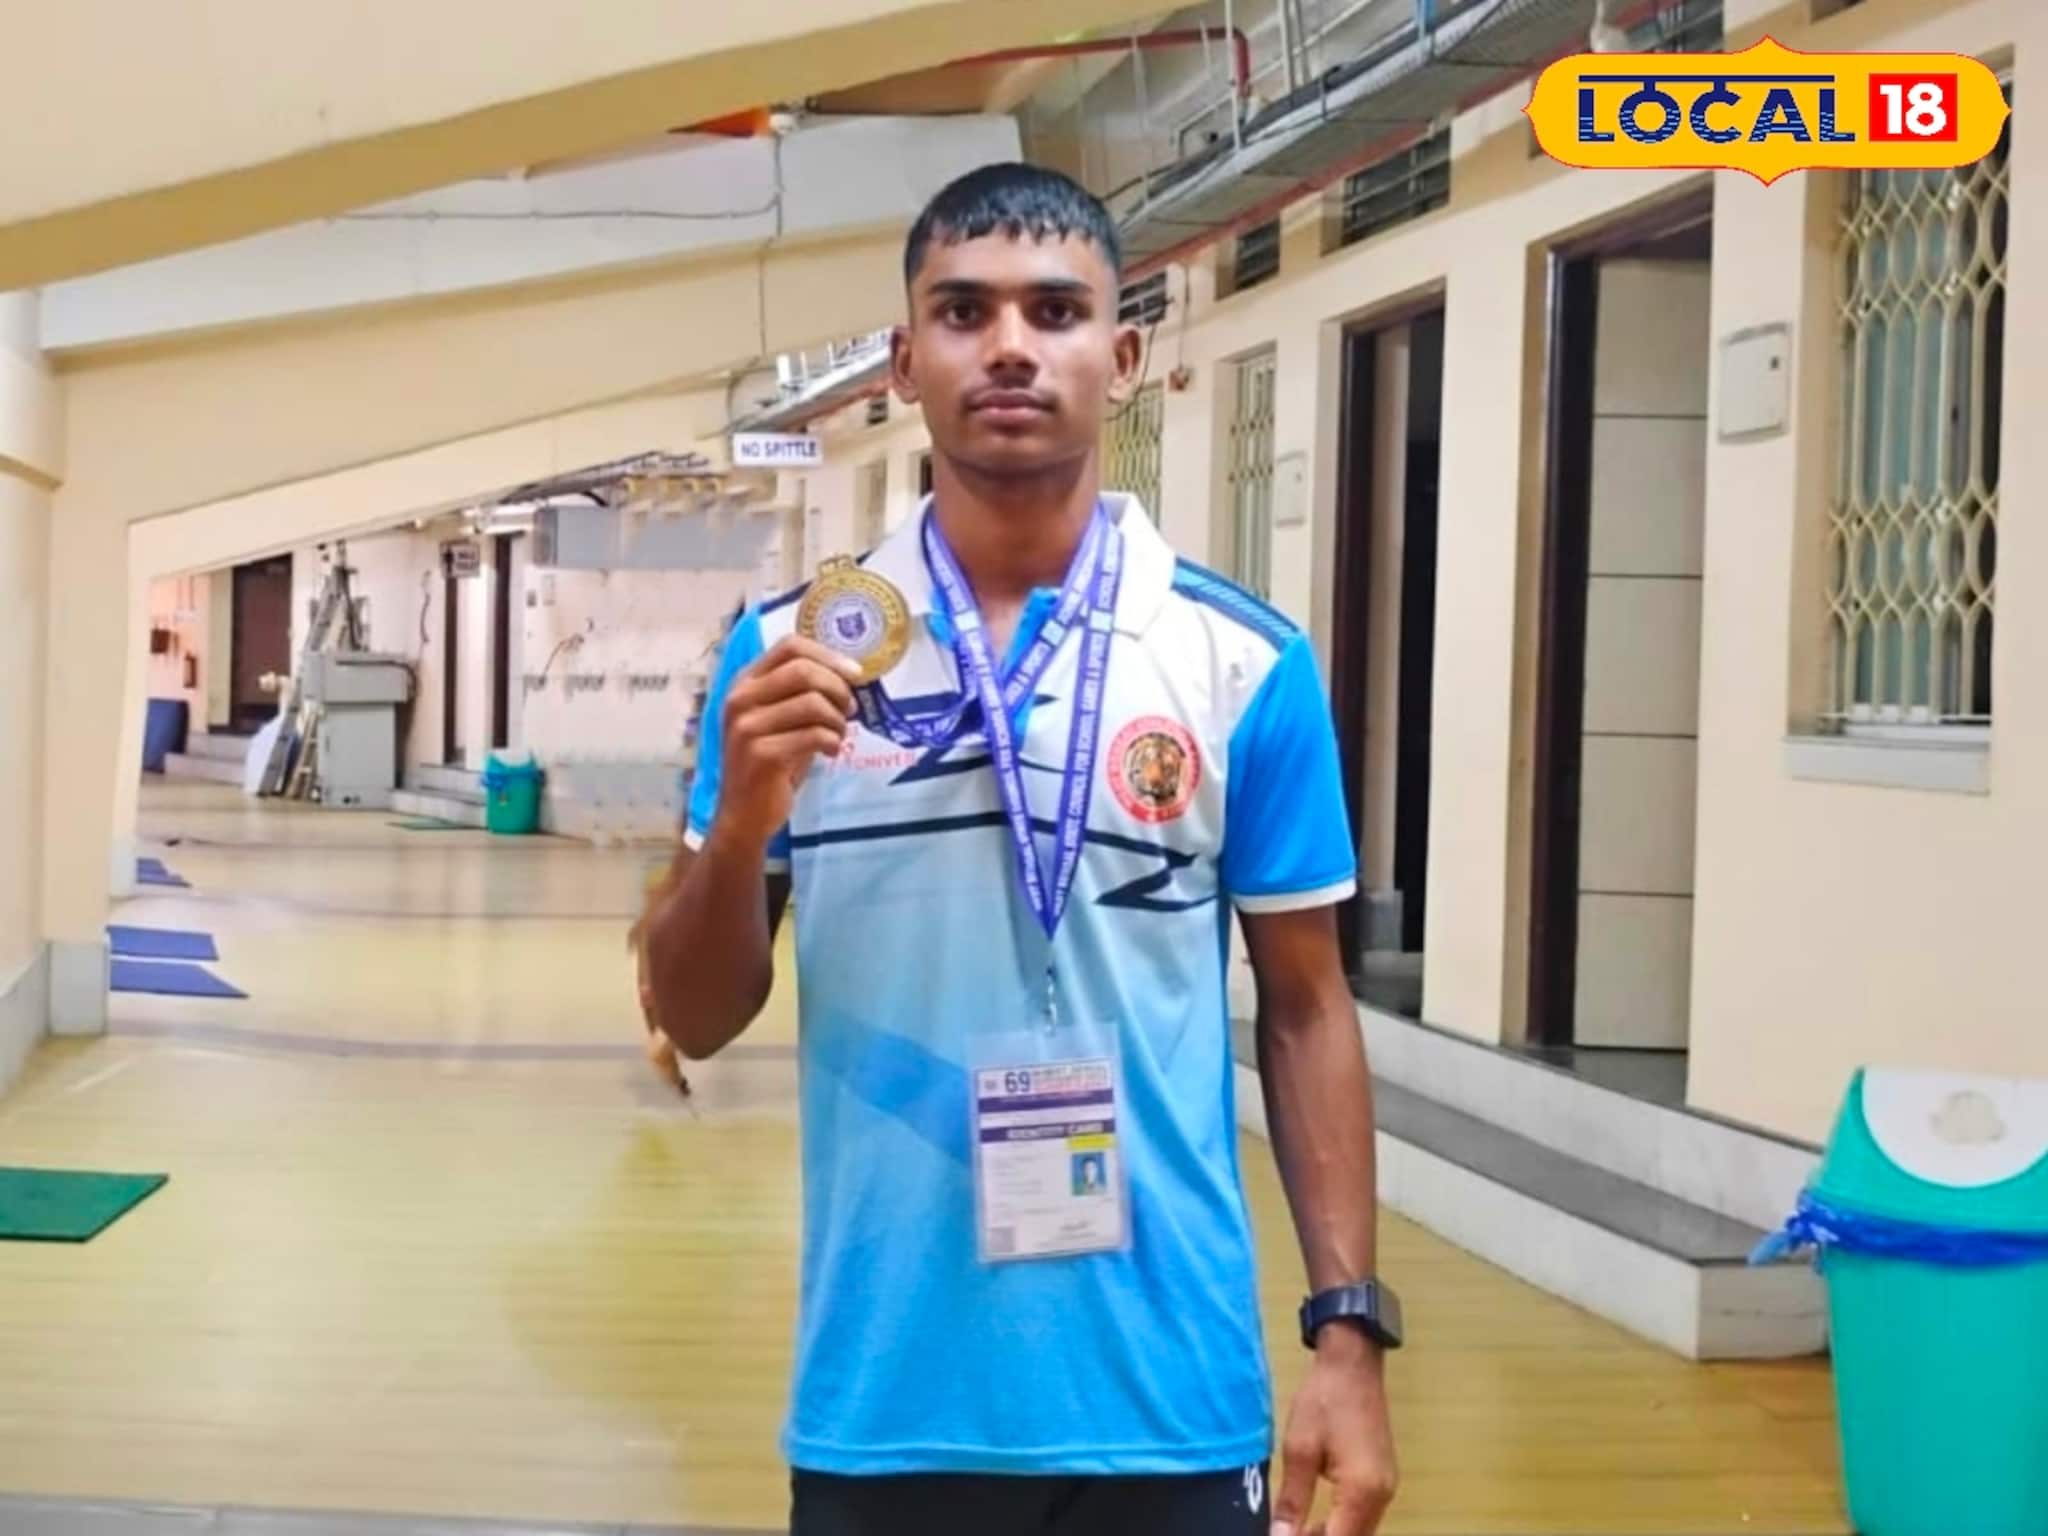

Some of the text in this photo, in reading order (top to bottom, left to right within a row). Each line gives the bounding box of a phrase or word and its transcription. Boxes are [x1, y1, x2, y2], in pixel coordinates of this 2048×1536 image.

[741, 441, 817, 457] NO SPITTLE
[1004, 1071, 1031, 1093] 69
